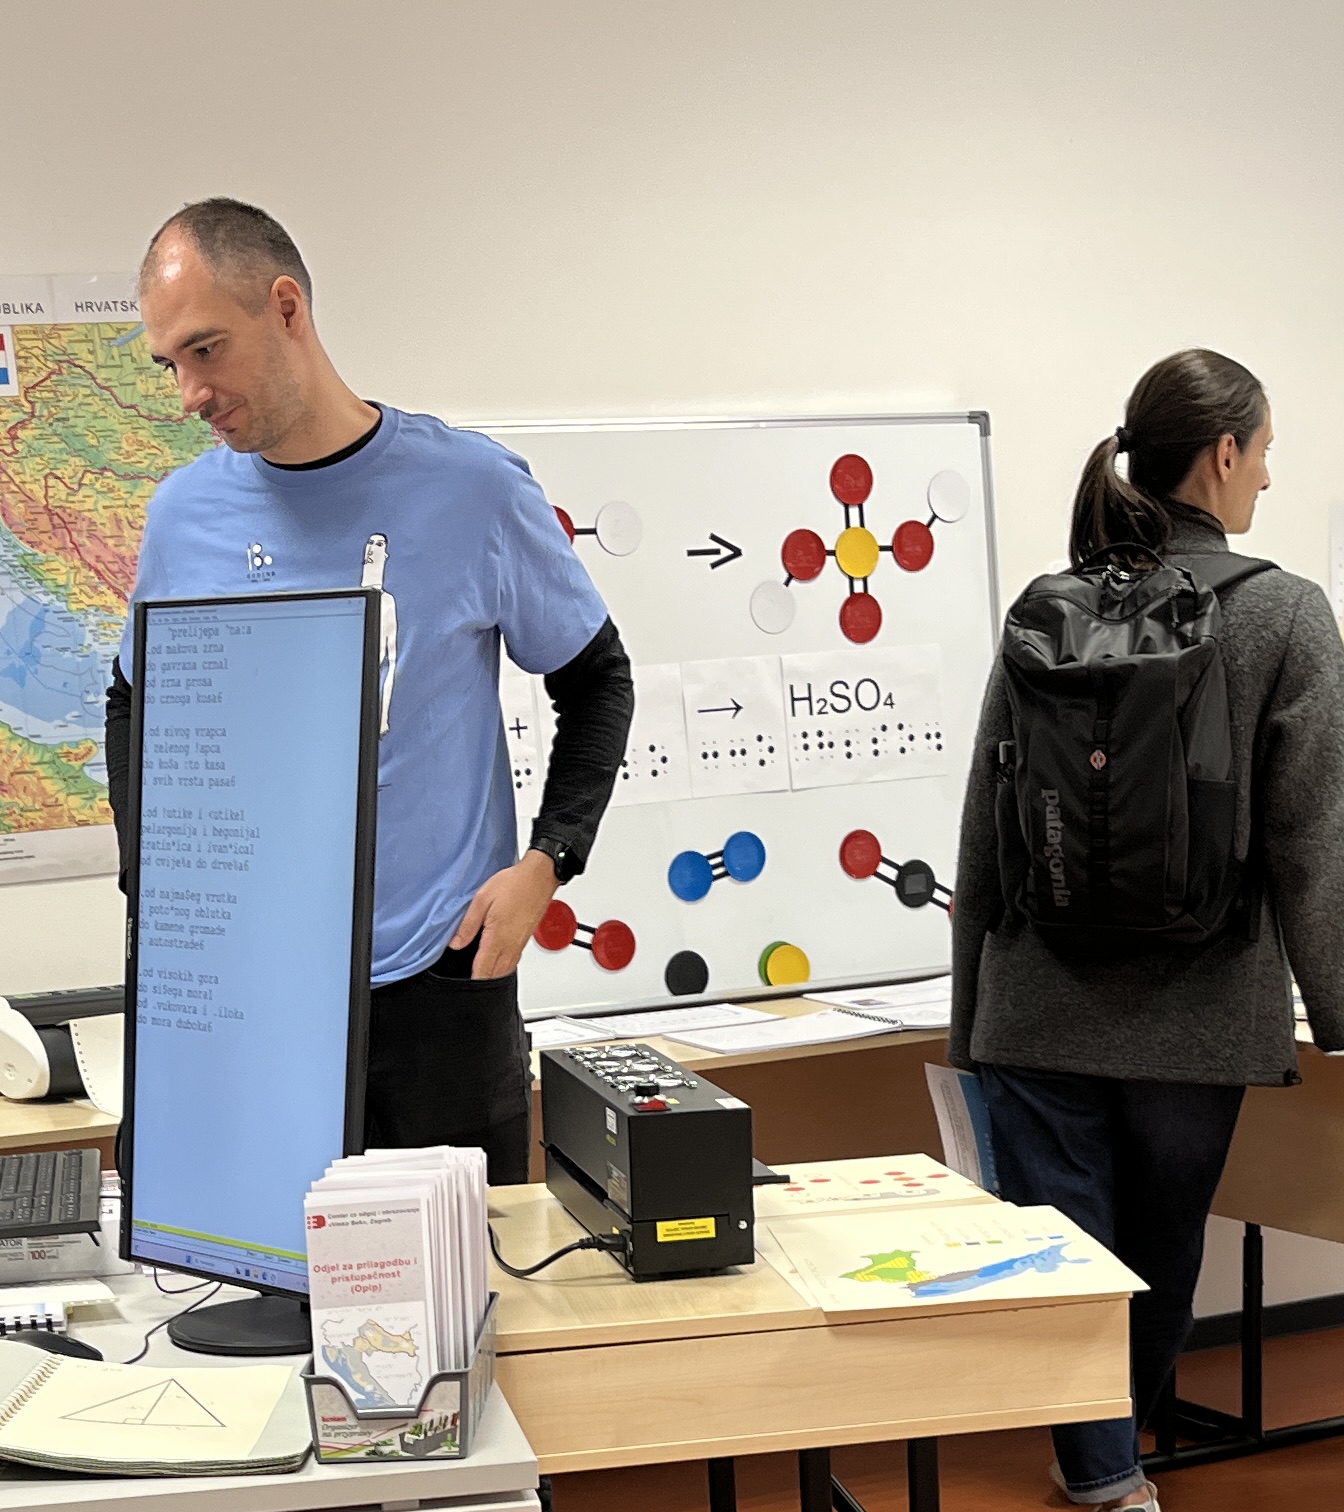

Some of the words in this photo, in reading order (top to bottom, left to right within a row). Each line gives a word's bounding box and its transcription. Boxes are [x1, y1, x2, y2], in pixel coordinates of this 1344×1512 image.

[74, 300, 140, 313] HRVATSK
[1040, 788, 1071, 908] patagonia
[30, 1249, 47, 1260] 100
[313, 1262, 339, 1274] Odjel
[342, 1262, 353, 1271] za
[356, 1258, 411, 1271] prilagodbu
[413, 1257, 418, 1265] i
[330, 1269, 401, 1284] pristupačnost
[350, 1283, 383, 1295] (Opip)
